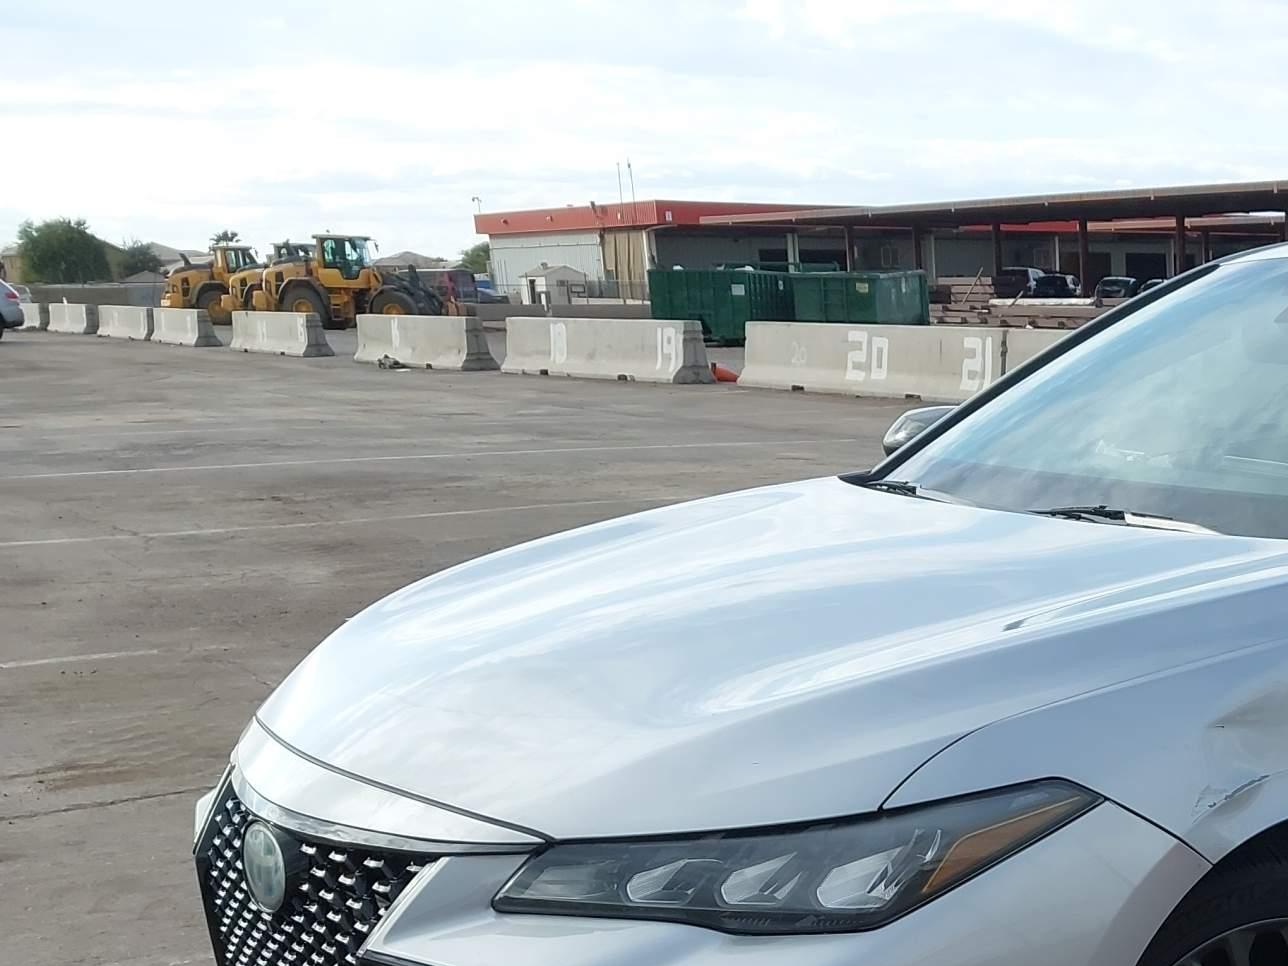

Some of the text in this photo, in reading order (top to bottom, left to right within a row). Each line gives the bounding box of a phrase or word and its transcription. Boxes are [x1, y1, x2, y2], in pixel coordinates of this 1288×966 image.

[656, 327, 676, 373] 19
[845, 330, 889, 381] 20
[960, 336, 993, 391] 21
